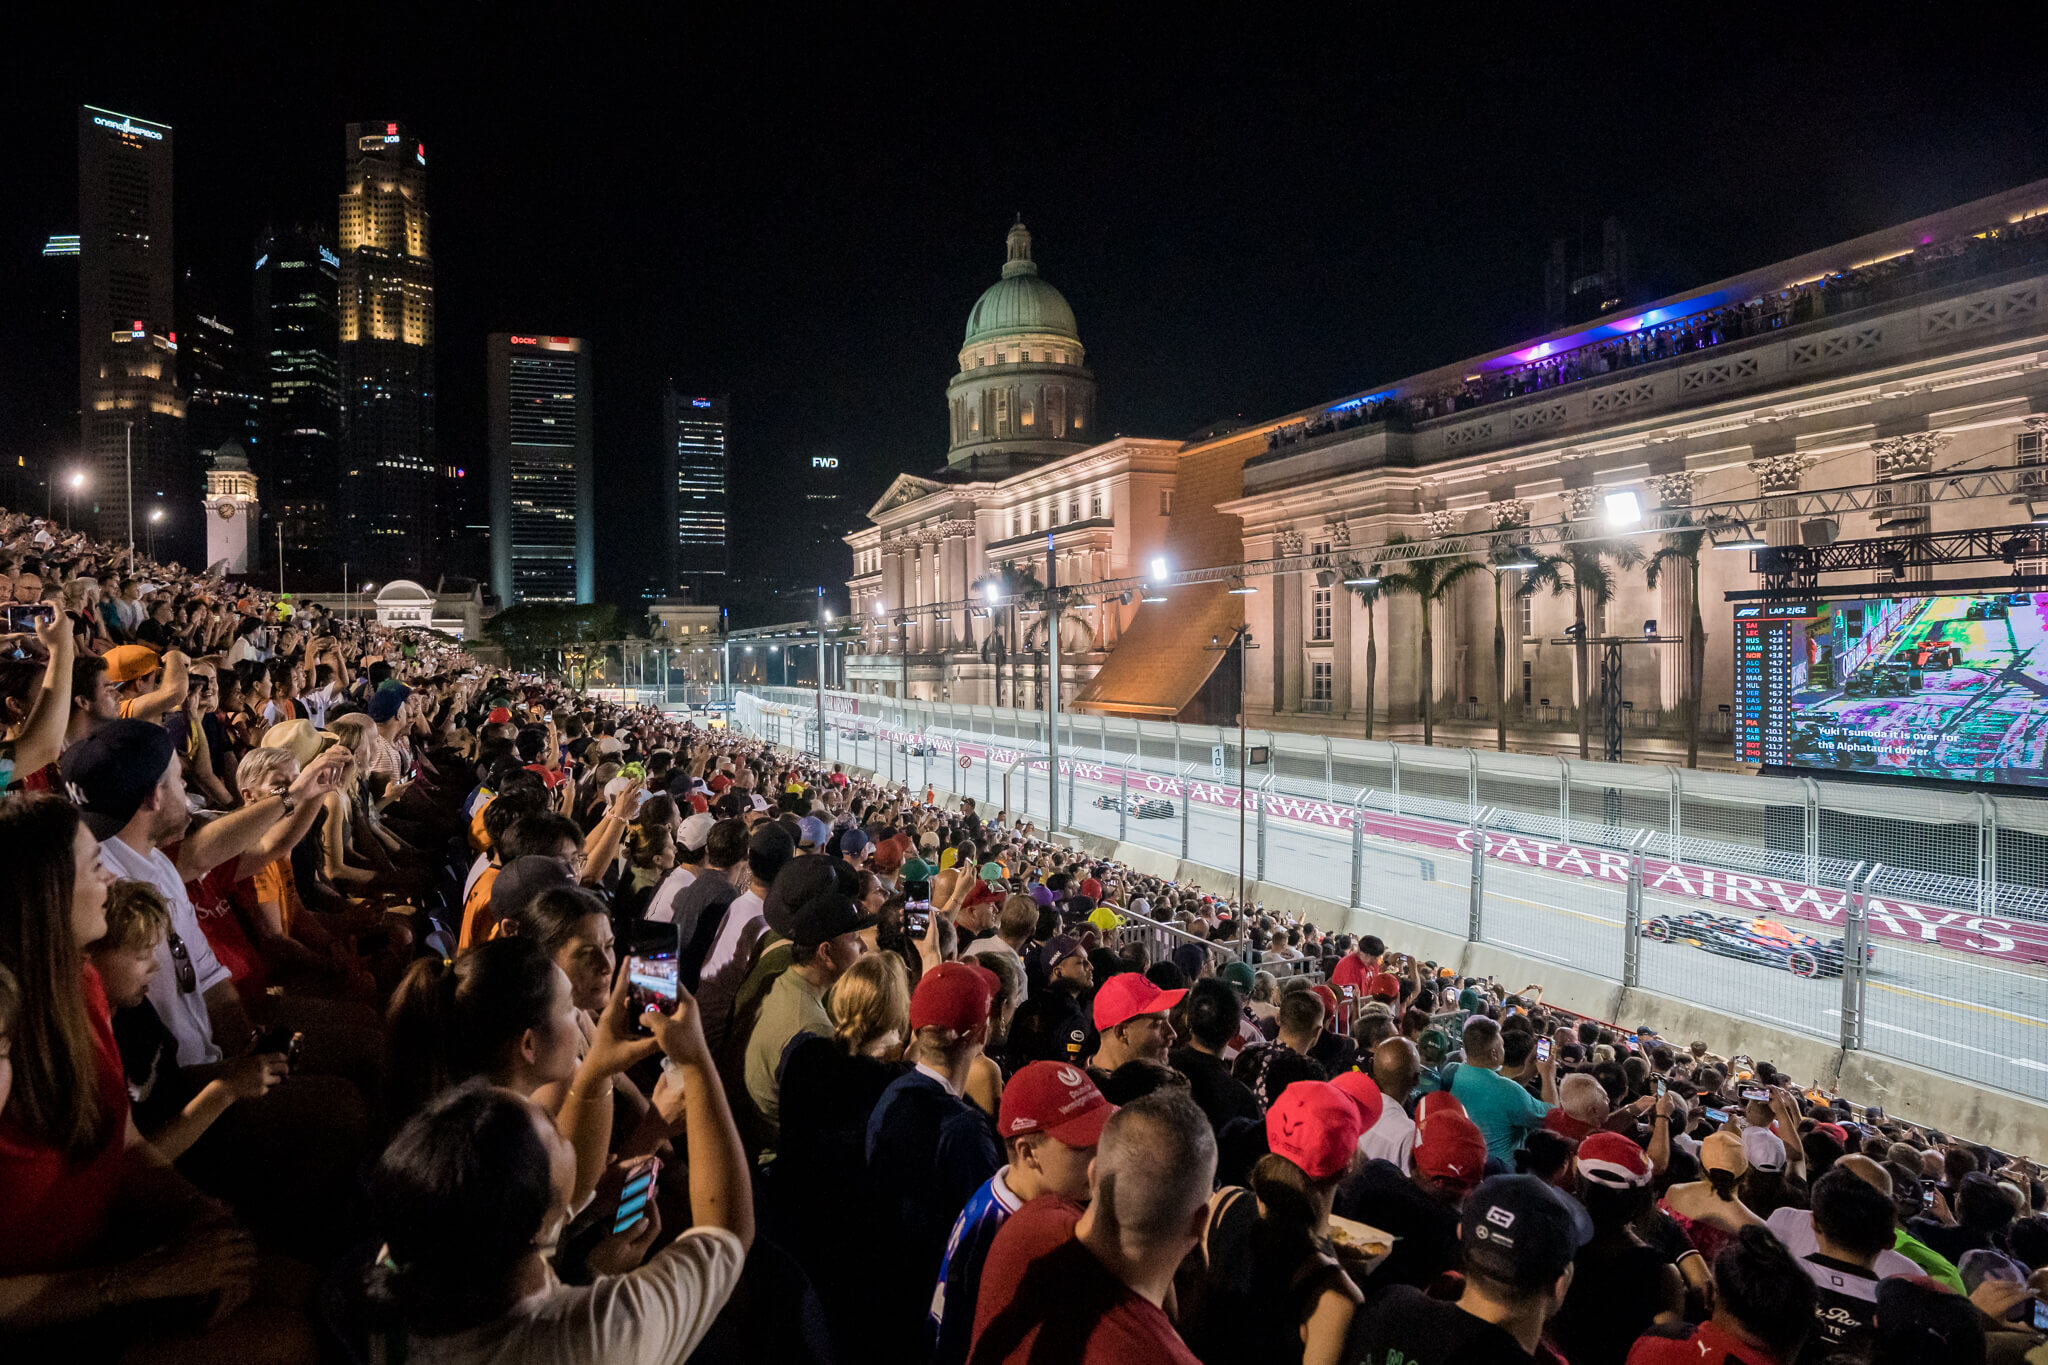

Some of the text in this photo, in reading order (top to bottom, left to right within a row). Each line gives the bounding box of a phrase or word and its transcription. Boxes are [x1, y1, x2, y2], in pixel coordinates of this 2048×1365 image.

[812, 457, 839, 468] FWD
[1818, 727, 1840, 736] Yuki
[1842, 728, 1887, 738] Tsunoda
[1889, 730, 1898, 739] it
[1901, 731, 1910, 740] is
[1942, 734, 1960, 742] for
[1818, 742, 1929, 756] the Alphatauri driver
[1145, 775, 1225, 805] QATAR
[1456, 829, 2016, 952] QATAR AIRWAYS
